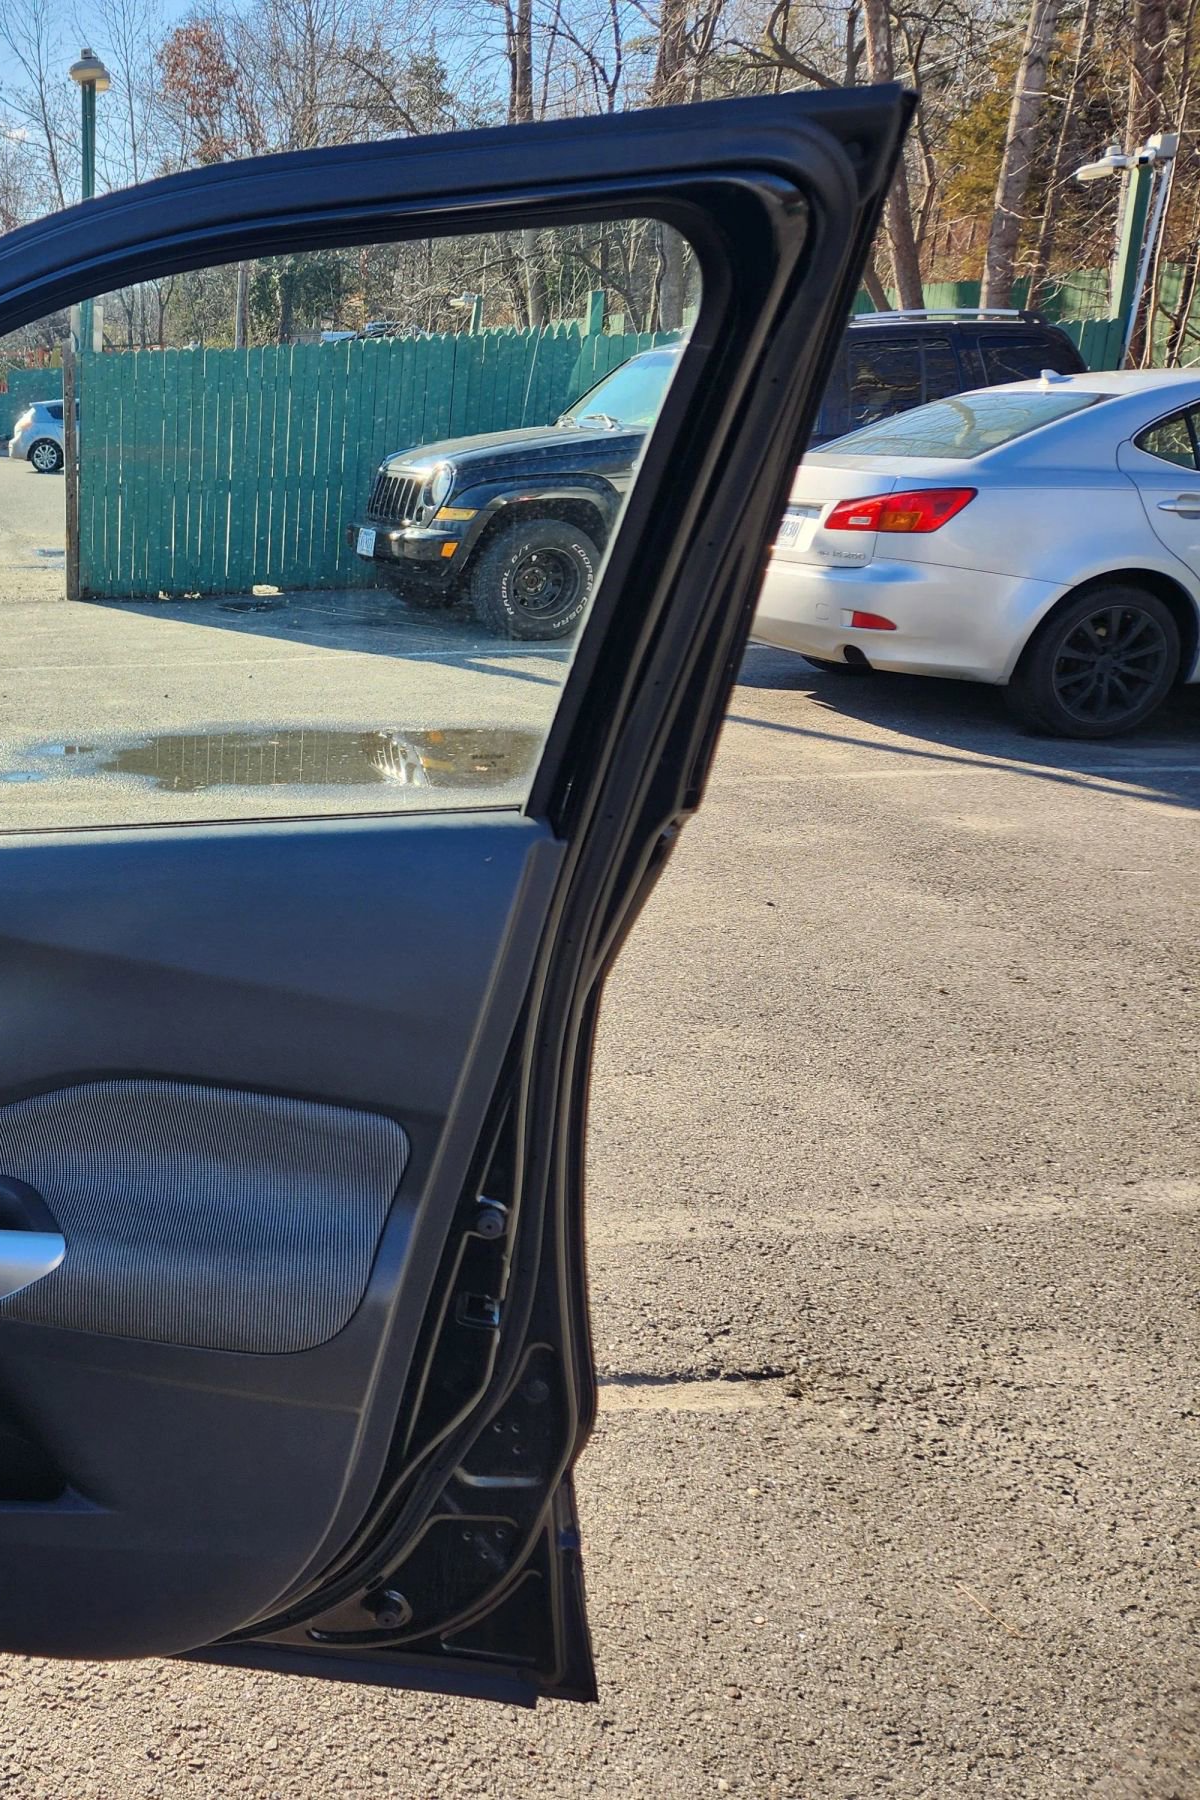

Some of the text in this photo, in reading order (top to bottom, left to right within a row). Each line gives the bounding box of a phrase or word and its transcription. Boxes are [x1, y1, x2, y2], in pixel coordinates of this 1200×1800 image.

[501, 569, 515, 616] RADIAL
[552, 543, 594, 629] COOPER COBRA
